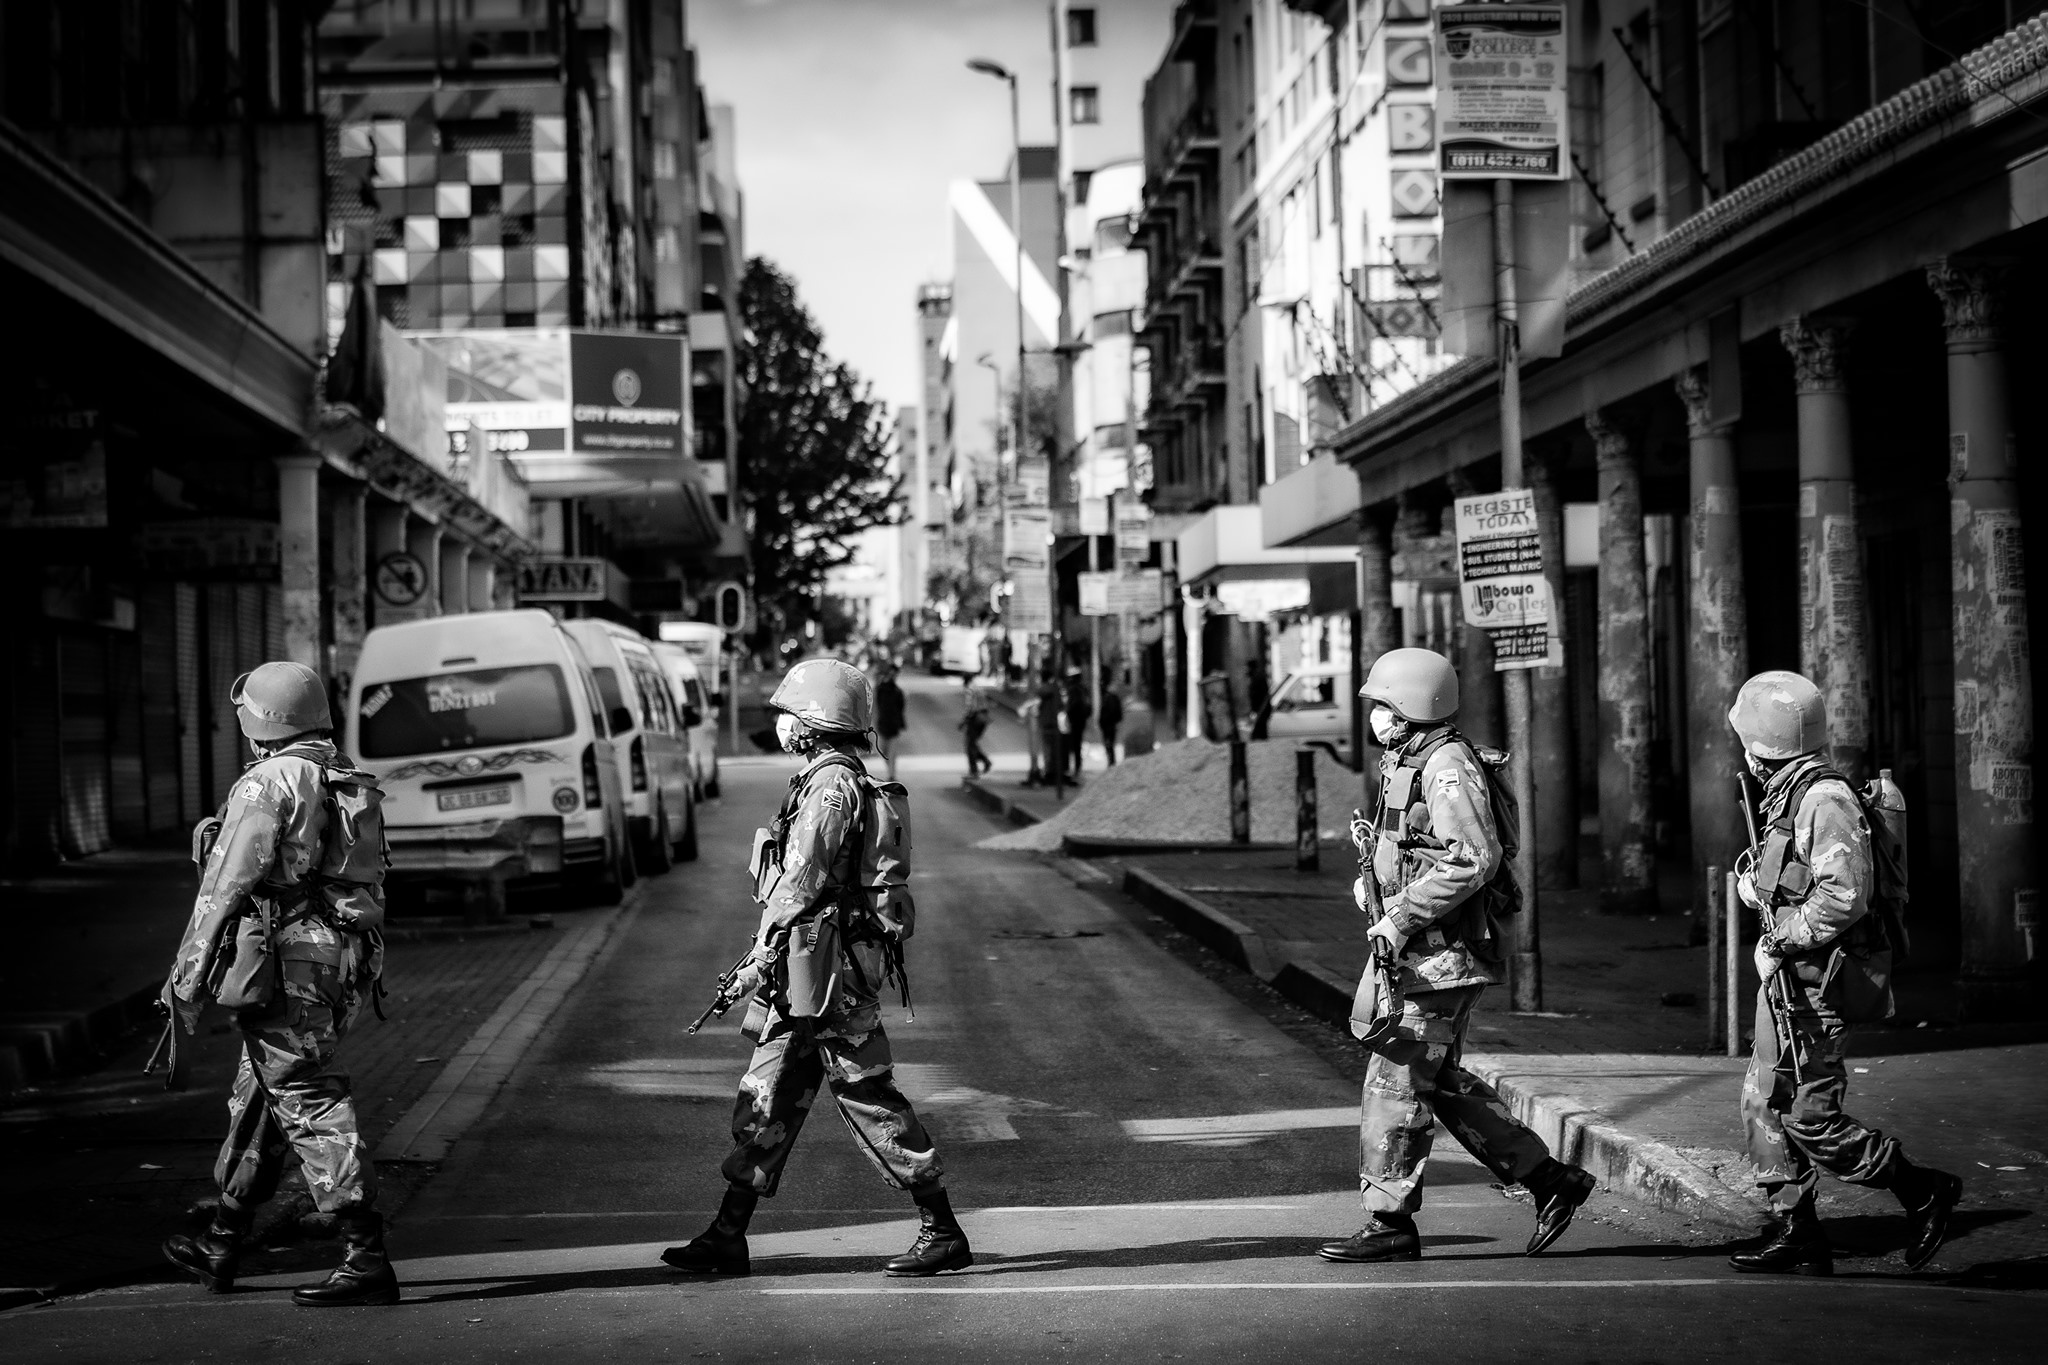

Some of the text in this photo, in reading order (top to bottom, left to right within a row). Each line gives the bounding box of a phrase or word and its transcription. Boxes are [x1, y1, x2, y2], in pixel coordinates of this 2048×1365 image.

[1472, 44, 1538, 54] COLLEGE
[1452, 156, 1485, 166] (011)
[574, 404, 606, 422] CITY
[1477, 513, 1530, 530] TODAY
[1466, 540, 1518, 554] ENGINEERING
[1468, 556, 1482, 566] BUS.
[1484, 552, 1518, 564] STUDIES
[1468, 561, 1542, 578] TECHNICAL MATRIC
